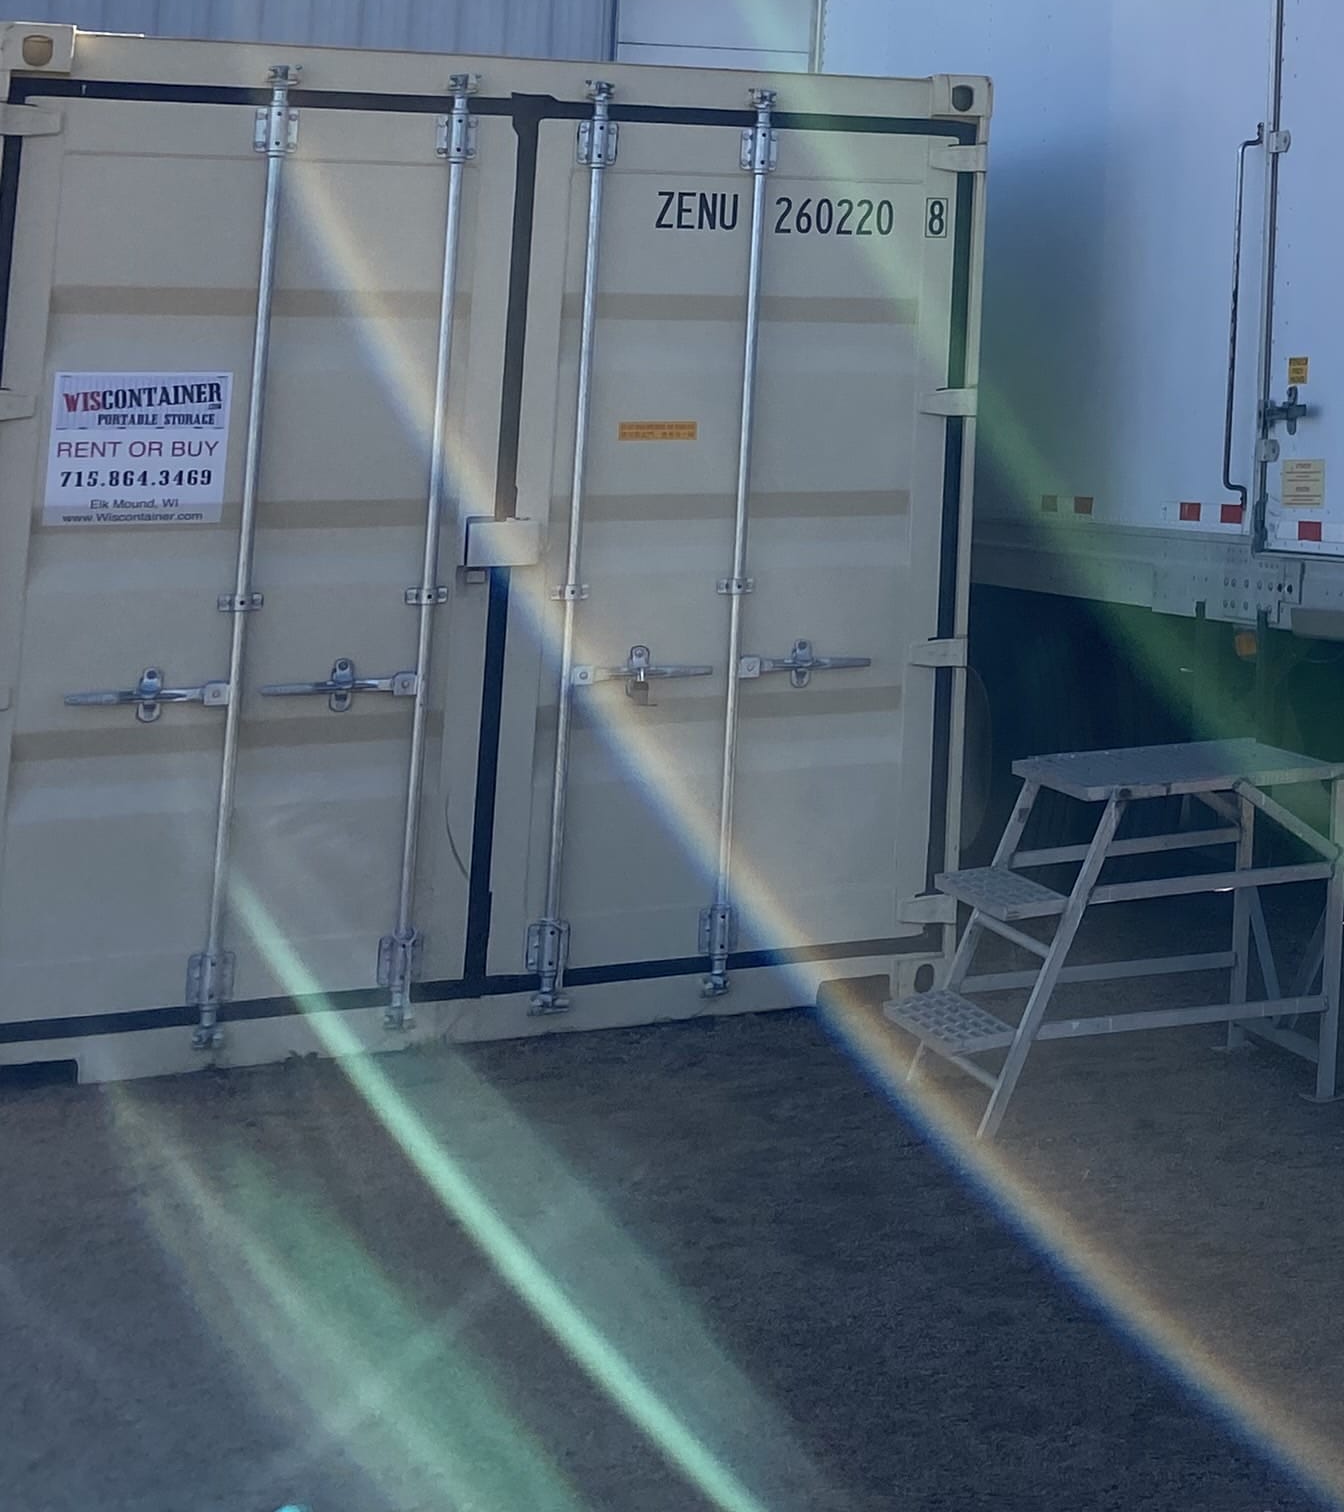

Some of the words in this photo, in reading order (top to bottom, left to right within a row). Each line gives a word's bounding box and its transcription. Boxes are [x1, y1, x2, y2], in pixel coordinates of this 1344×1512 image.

[655, 191, 739, 231] ZENU
[774, 196, 894, 236] 260220
[927, 200, 946, 236] 8
[63, 382, 222, 413] WISCONTAINER
[97, 414, 158, 426] PORTABLE
[163, 413, 216, 425] STORAGE
[57, 441, 123, 458] RENT
[128, 440, 163, 458] OR
[171, 440, 220, 457] BUY
[60, 469, 213, 487] 715.864.3469
[90, 499, 109, 510] Elk
[162, 498, 179, 508] WI
